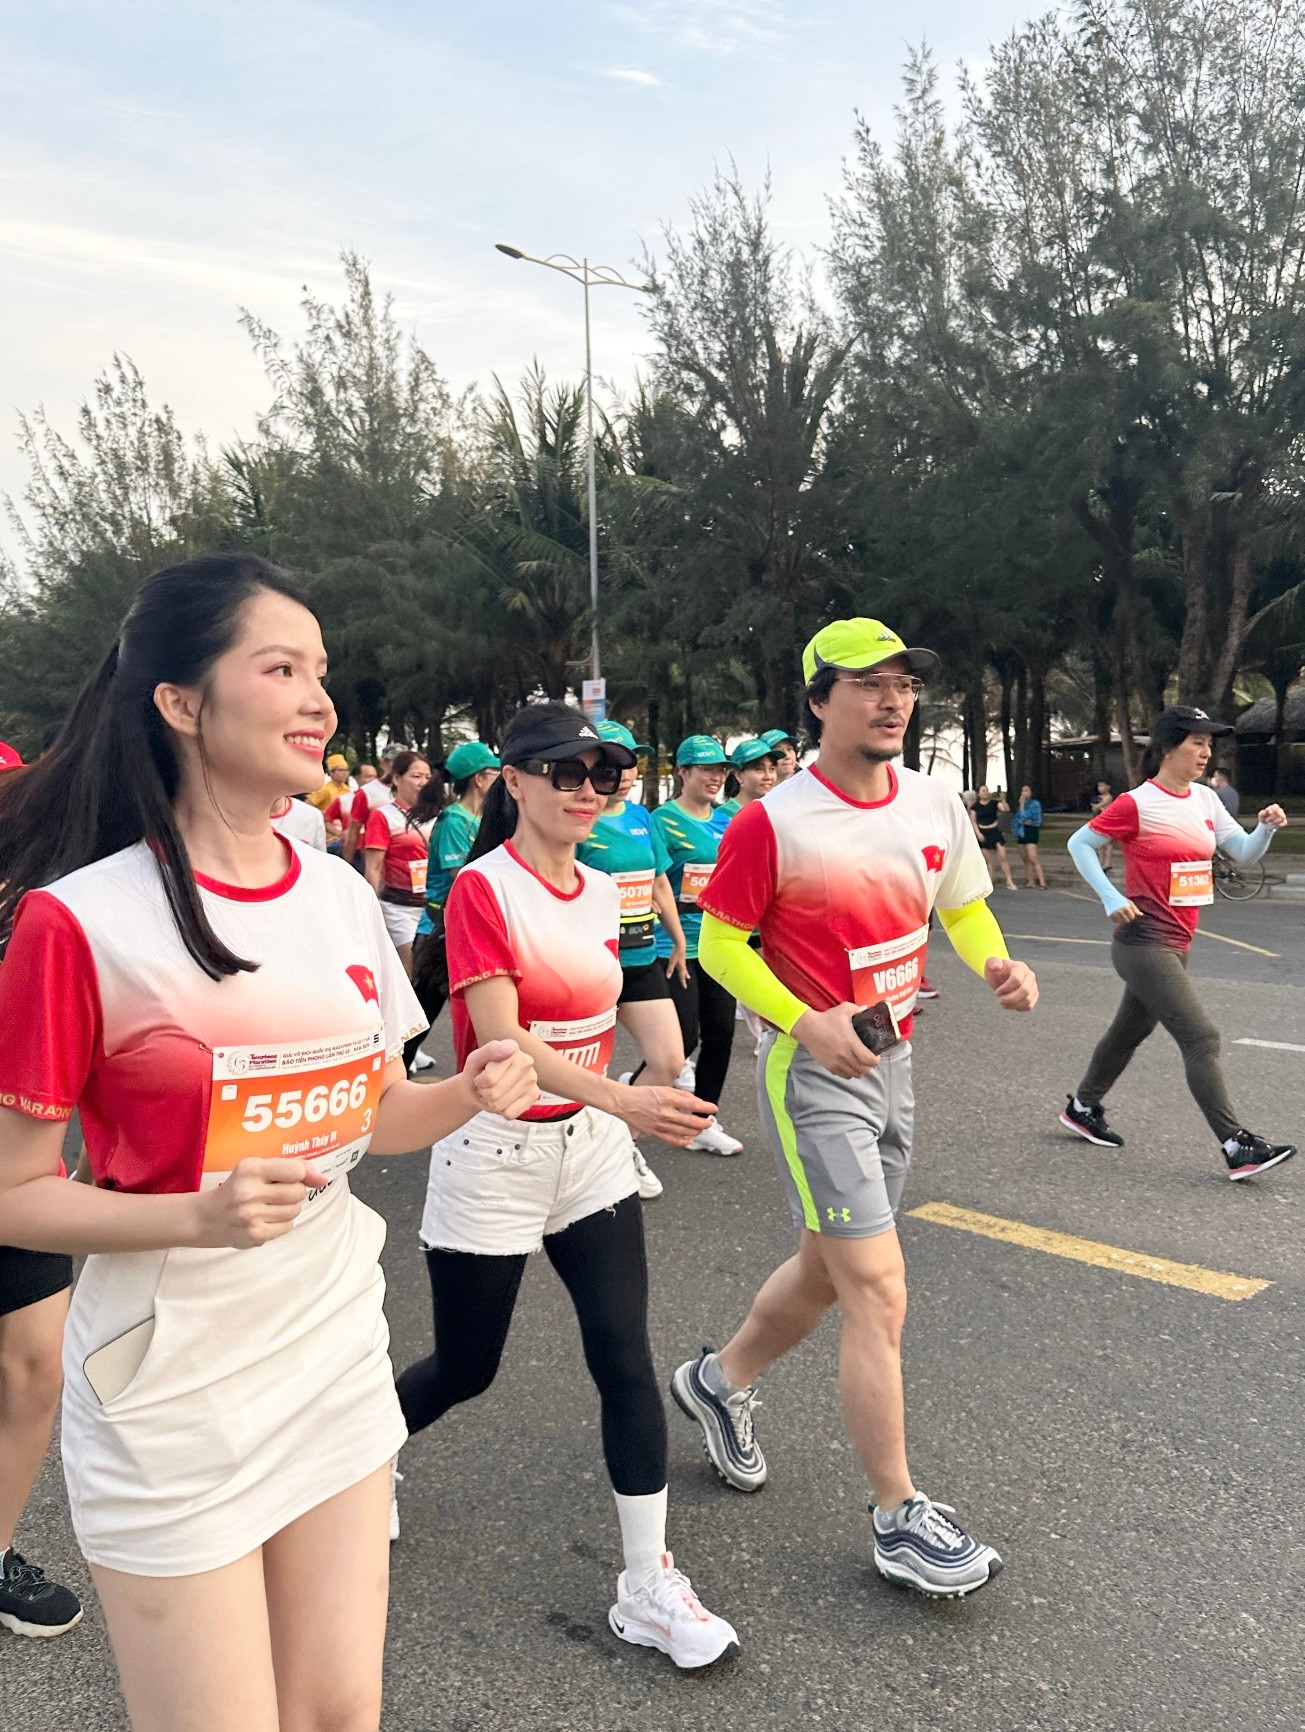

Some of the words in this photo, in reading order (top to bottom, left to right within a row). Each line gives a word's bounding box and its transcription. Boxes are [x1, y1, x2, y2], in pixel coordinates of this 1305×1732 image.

[872, 956, 919, 995] V6666
[307, 1054, 325, 1062] PHONG
[241, 1073, 369, 1133] 55666
[360, 1107, 373, 1133] 3
[281, 1138, 310, 1156] Huỳnh
